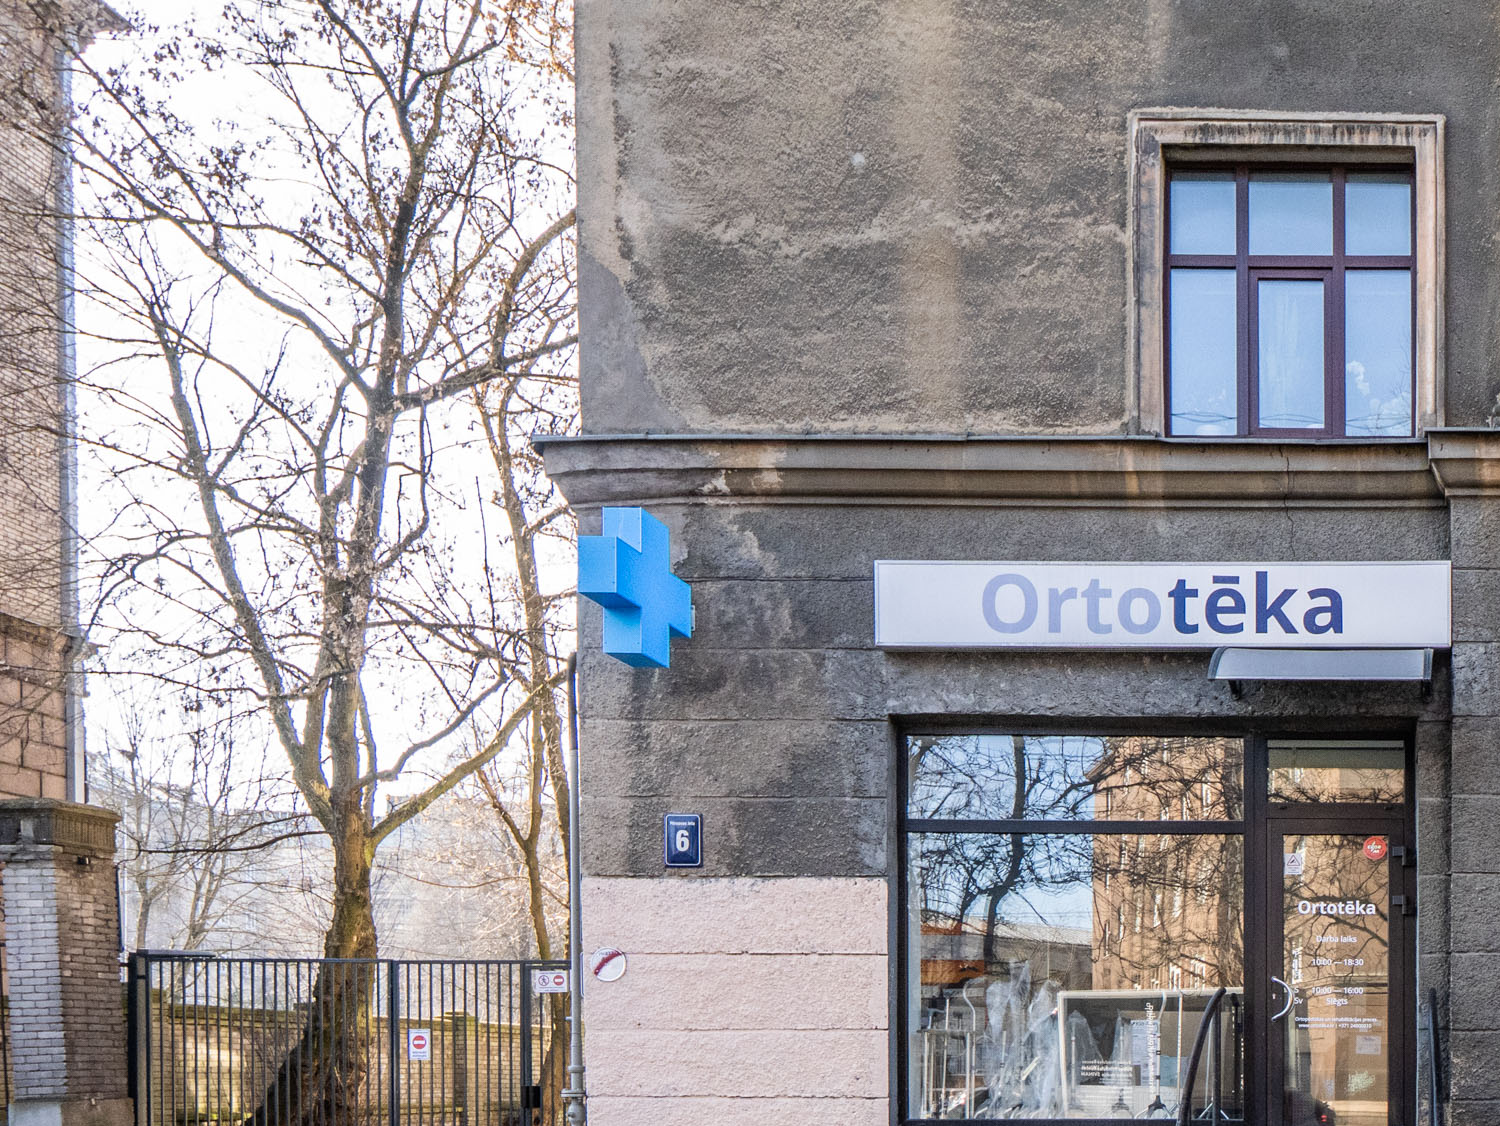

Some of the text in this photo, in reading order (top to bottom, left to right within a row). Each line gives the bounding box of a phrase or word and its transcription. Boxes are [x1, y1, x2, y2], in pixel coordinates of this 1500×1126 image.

[981, 570, 1344, 636] Ortotēka
[676, 829, 690, 852] 6
[1297, 899, 1376, 915] Ortotēka
[1316, 935, 1357, 943] Darba laiks
[1343, 958, 1364, 966] 18:30
